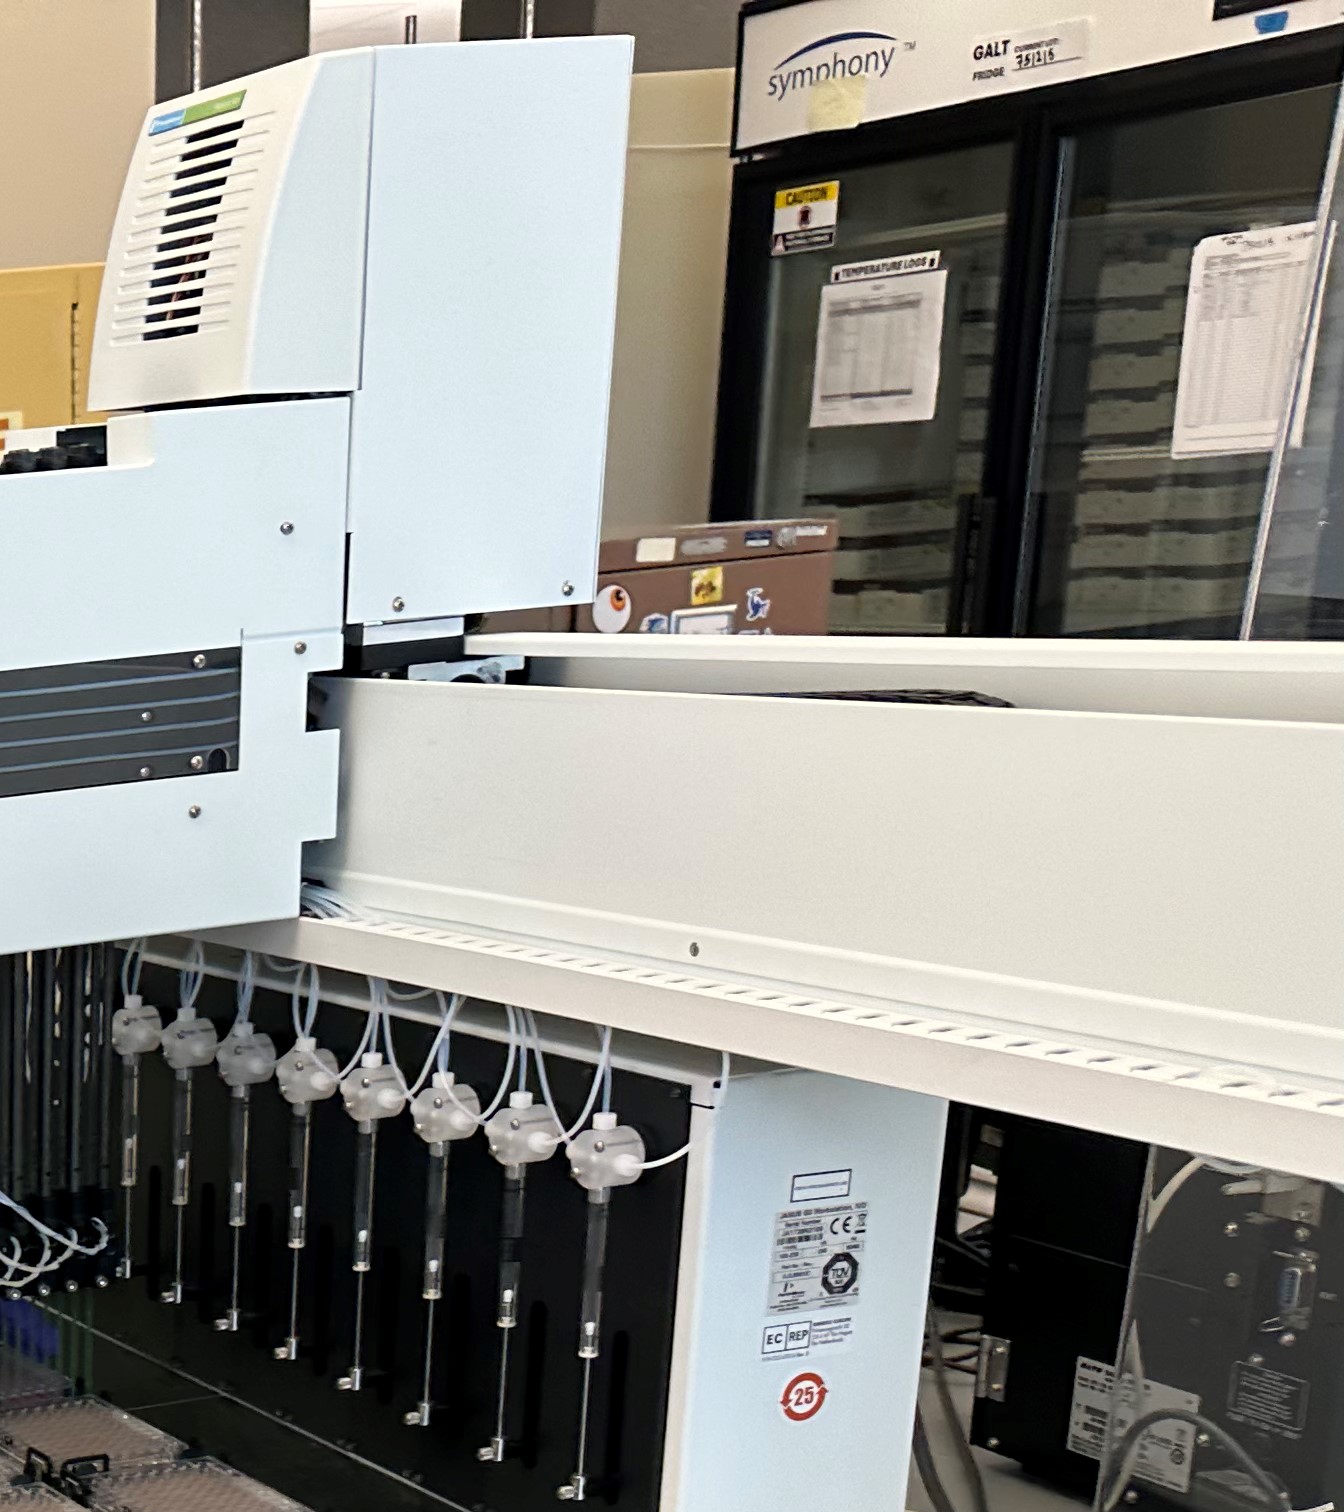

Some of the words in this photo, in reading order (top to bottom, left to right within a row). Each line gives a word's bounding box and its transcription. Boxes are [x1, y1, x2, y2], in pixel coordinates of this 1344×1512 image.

[973, 39, 1011, 61] GALT
[972, 66, 1006, 81] FRIDGE
[786, 187, 828, 205] CAUTION
[841, 261, 903, 279] TEMPERATURE
[767, 1333, 783, 1345] EC
[789, 1329, 809, 1341] REP
[794, 1386, 814, 1406] 25
